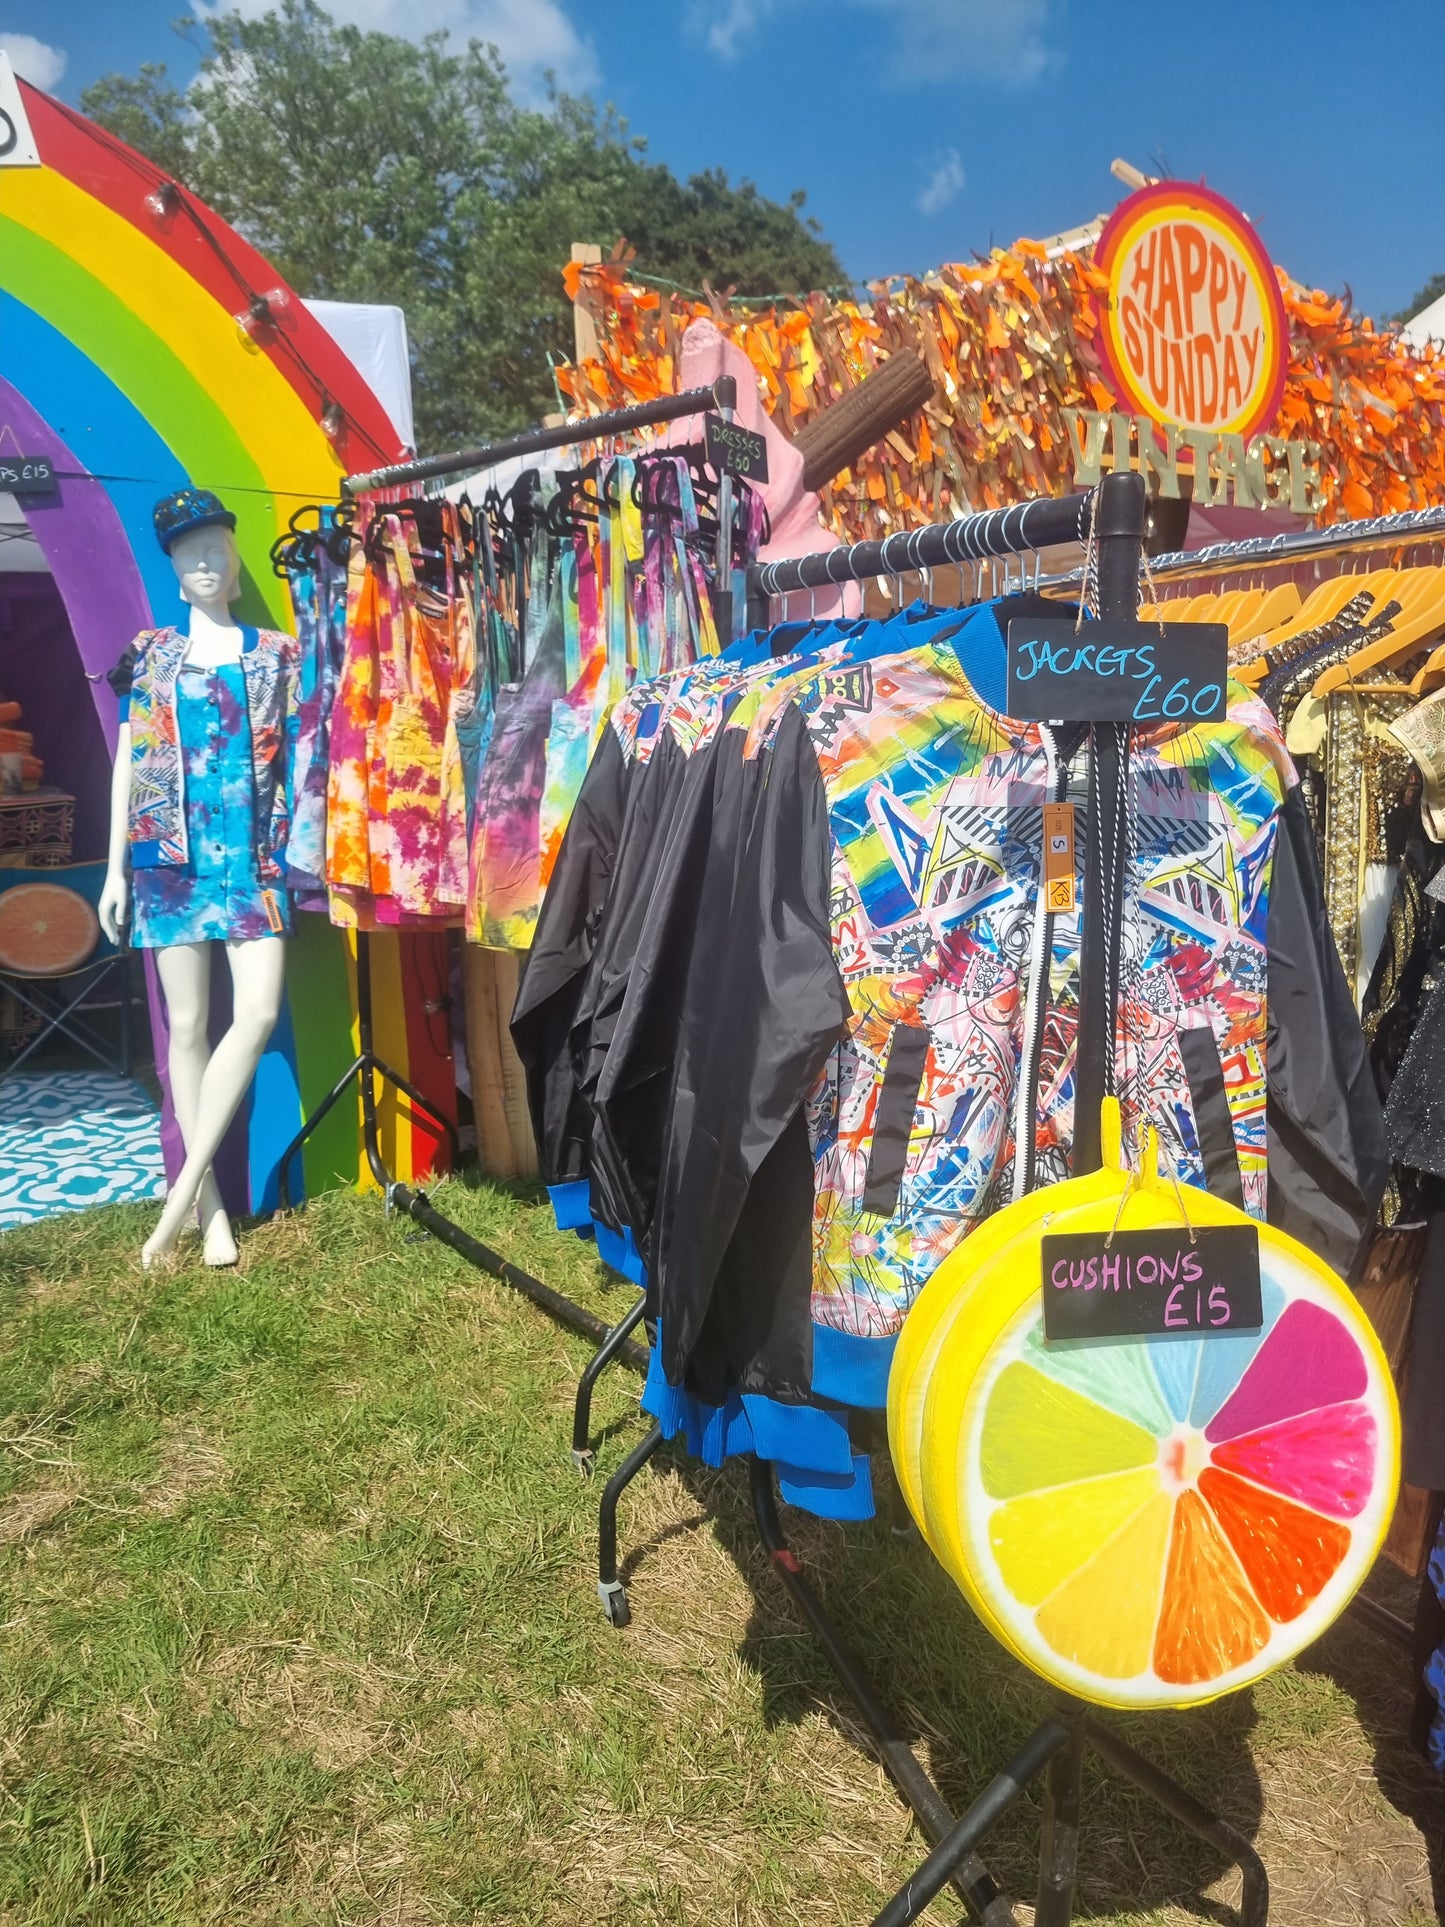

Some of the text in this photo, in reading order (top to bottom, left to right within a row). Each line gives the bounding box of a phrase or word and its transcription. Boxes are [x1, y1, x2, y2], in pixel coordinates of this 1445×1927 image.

[1131, 224, 1247, 343] HAPPY
[1121, 295, 1260, 424] SUNDAY
[711, 424, 761, 460] DRESSES
[727, 449, 751, 472] £60
[1063, 408, 1328, 513] VINTAGE
[0, 464, 49, 483] PS £15
[1015, 640, 1156, 681] JACKETS
[1132, 674, 1222, 721] £60
[1051, 1250, 1204, 1291] CUSHIONS
[1163, 1283, 1231, 1327] £15
